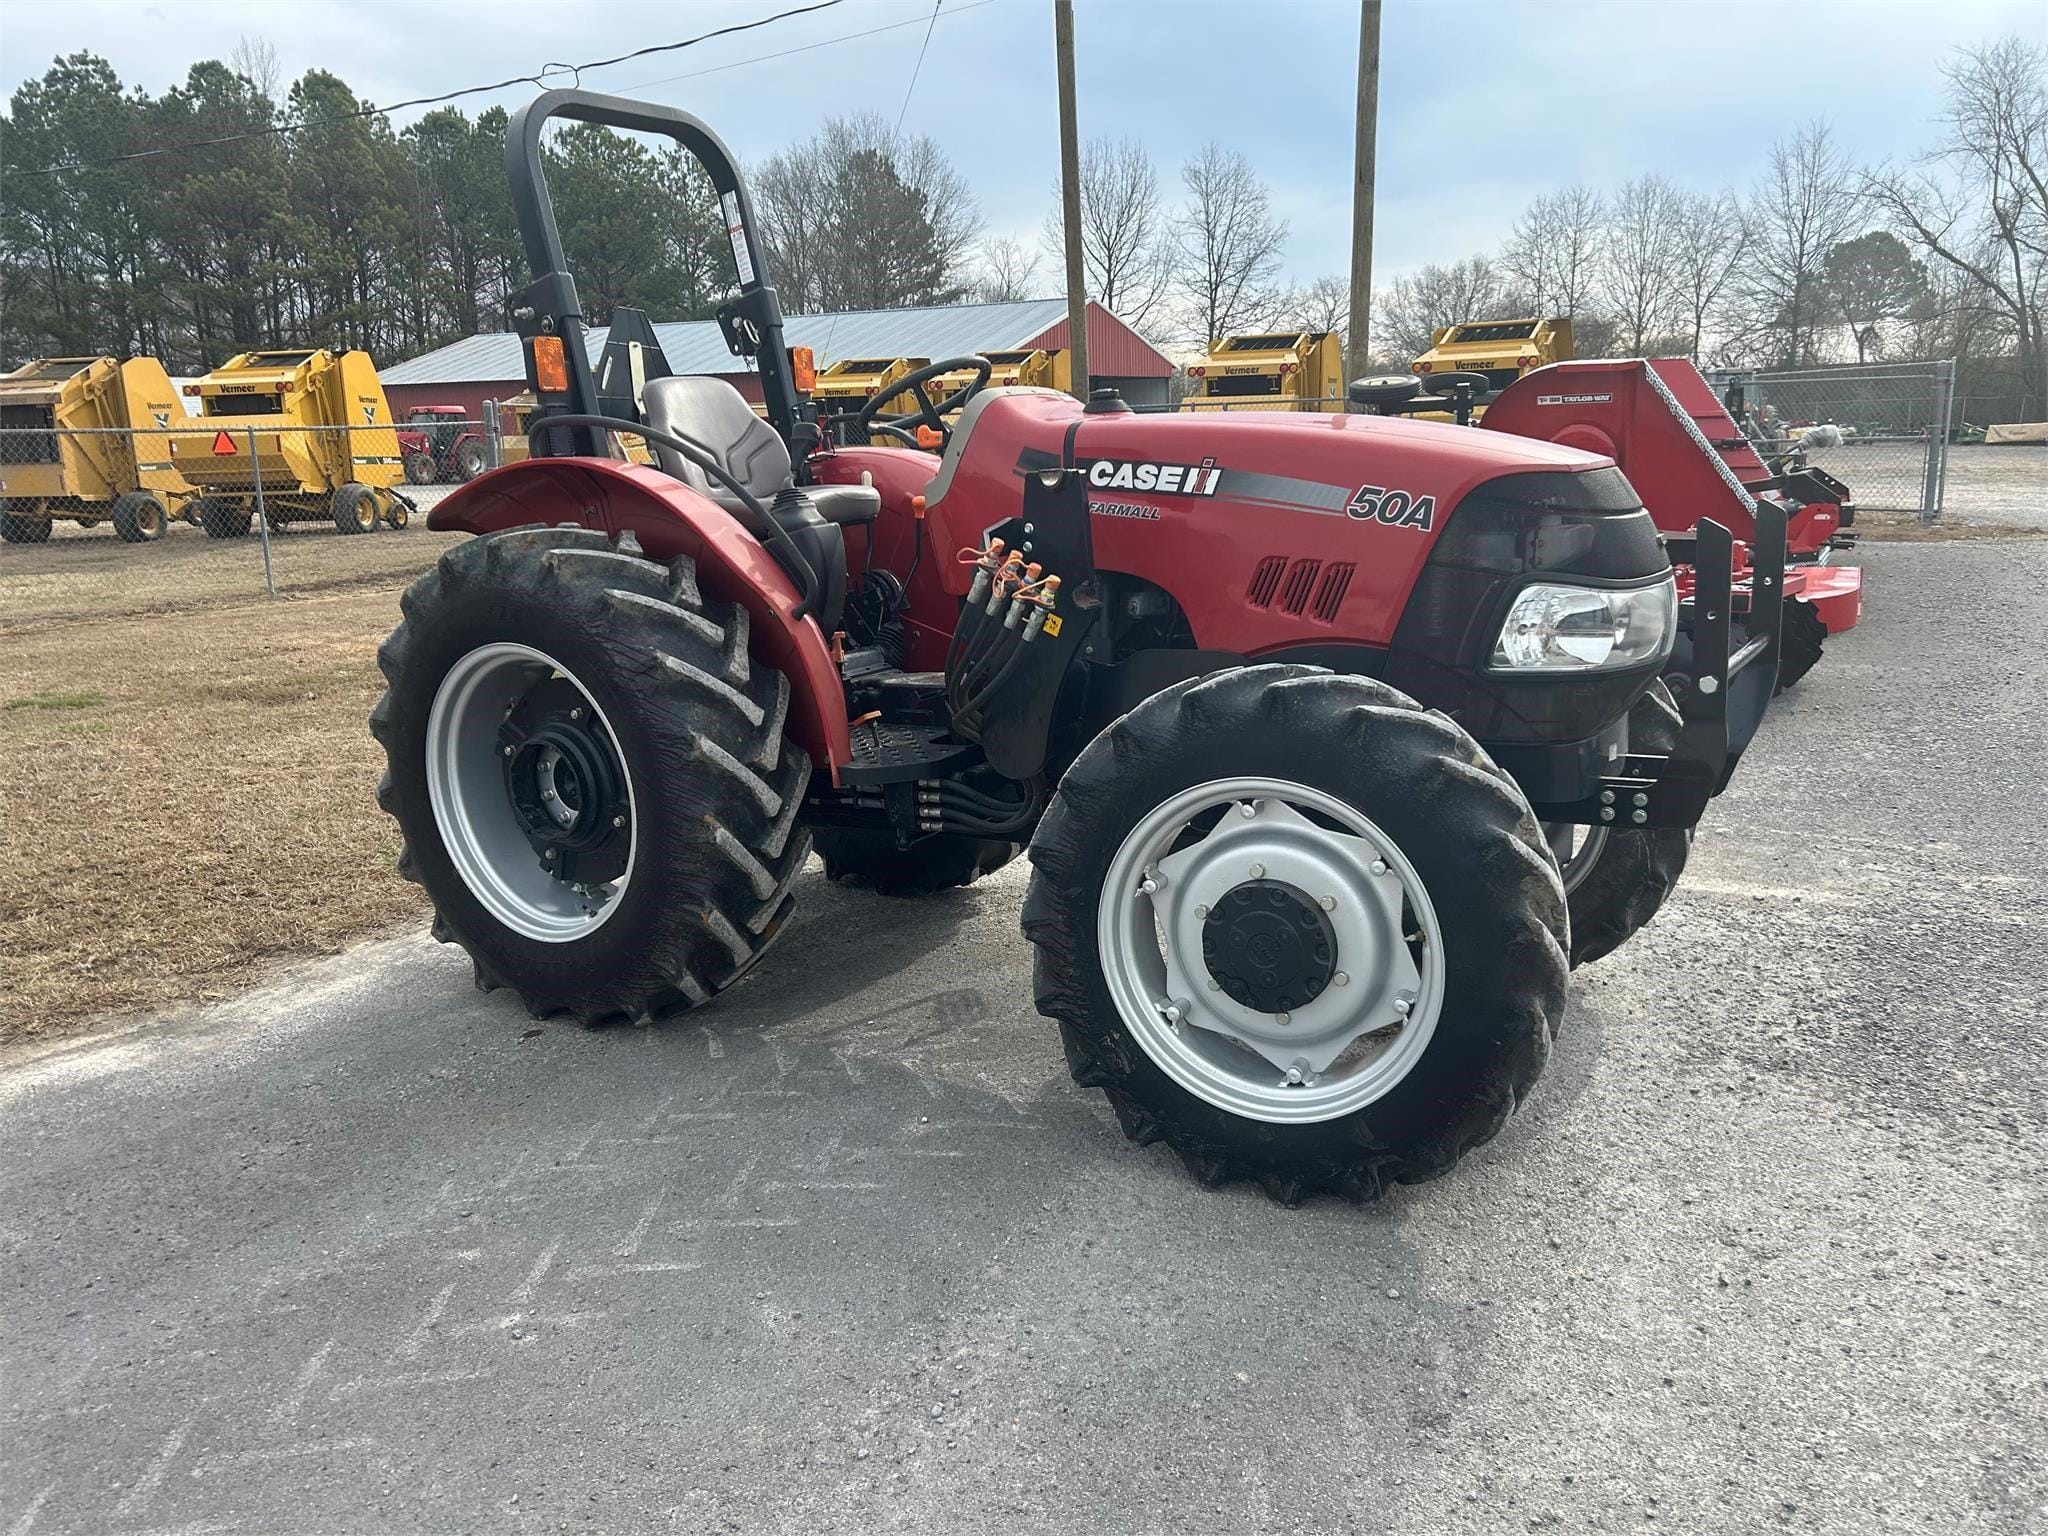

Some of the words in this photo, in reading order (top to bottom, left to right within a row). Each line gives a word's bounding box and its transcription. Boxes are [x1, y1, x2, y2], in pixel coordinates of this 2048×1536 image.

[1455, 360, 1496, 370] Vermeer
[1224, 366, 1260, 375] Vermeer
[219, 384, 256, 393] Vermeer
[824, 388, 851, 396] Vermeer
[1089, 460, 1185, 492] CASE
[1088, 502, 1161, 521] FARMALL
[1346, 484, 1437, 533] 50A
